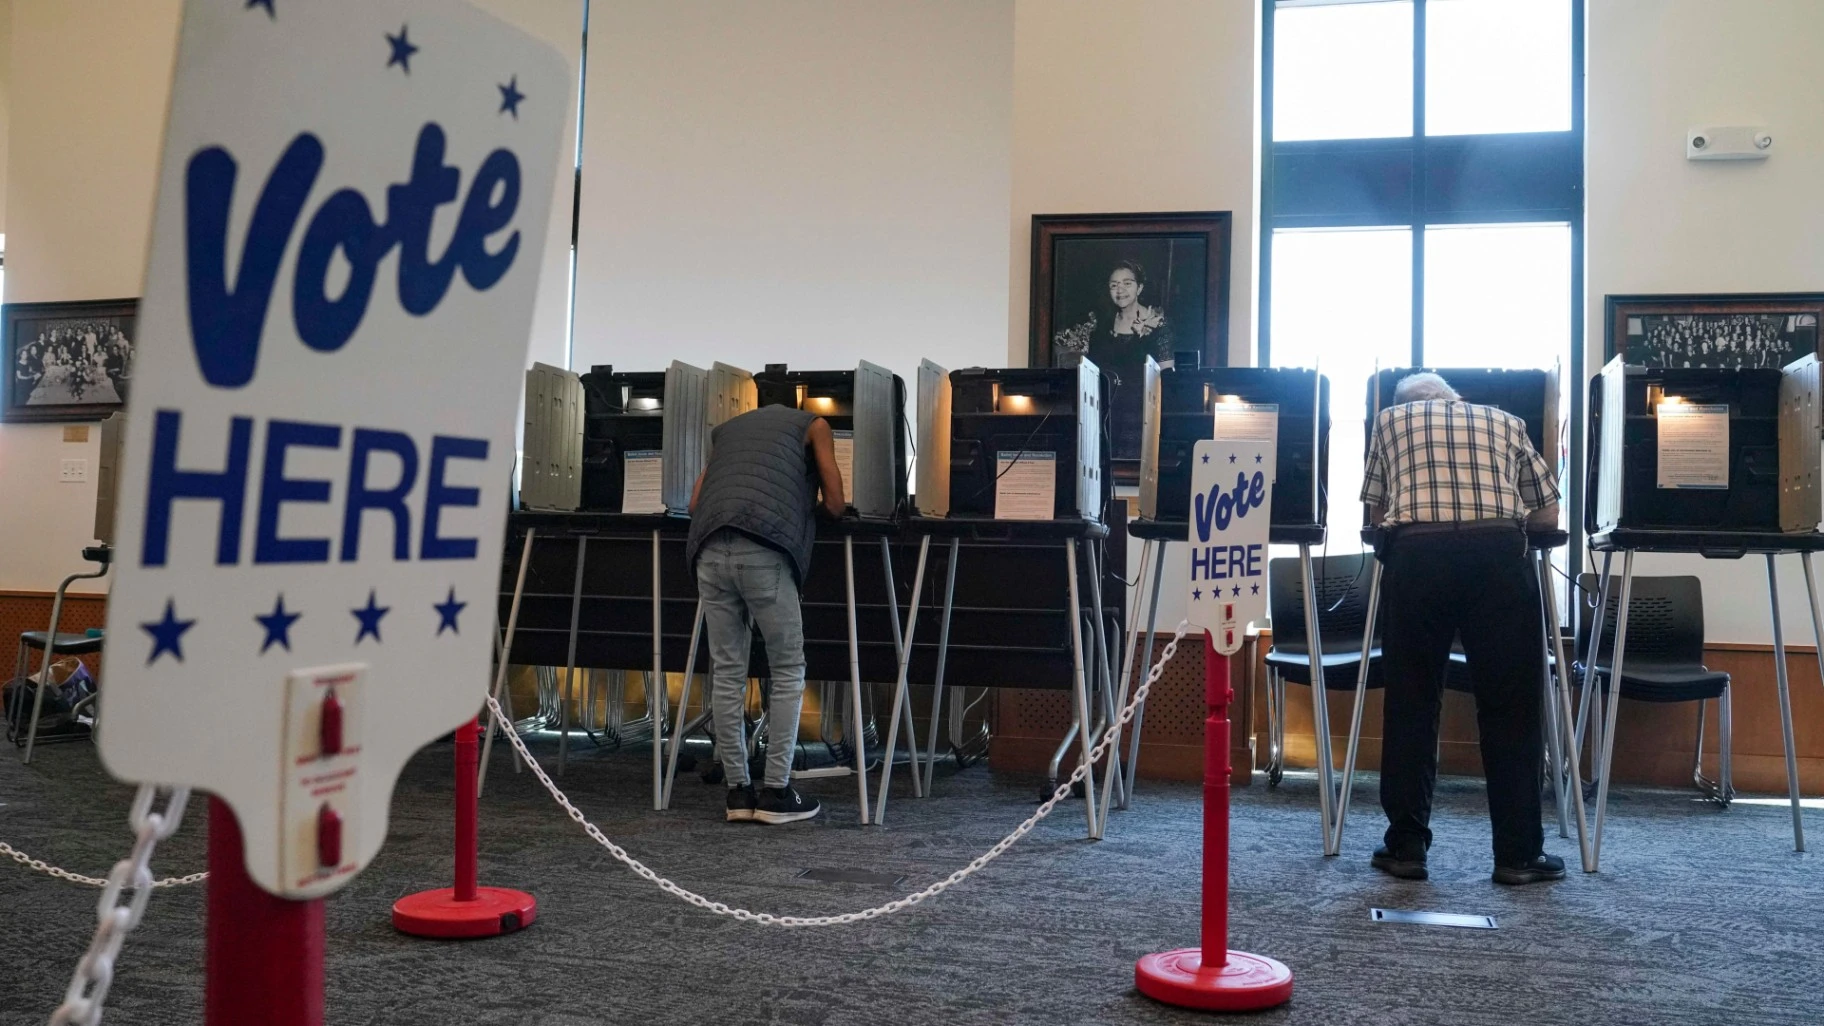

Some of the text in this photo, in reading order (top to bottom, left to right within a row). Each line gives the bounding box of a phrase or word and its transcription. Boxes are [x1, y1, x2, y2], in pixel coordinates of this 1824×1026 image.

[186, 122, 522, 389] Vote
[142, 410, 489, 567] HERE
[1195, 471, 1265, 542] Vote
[1191, 544, 1262, 581] HERE
